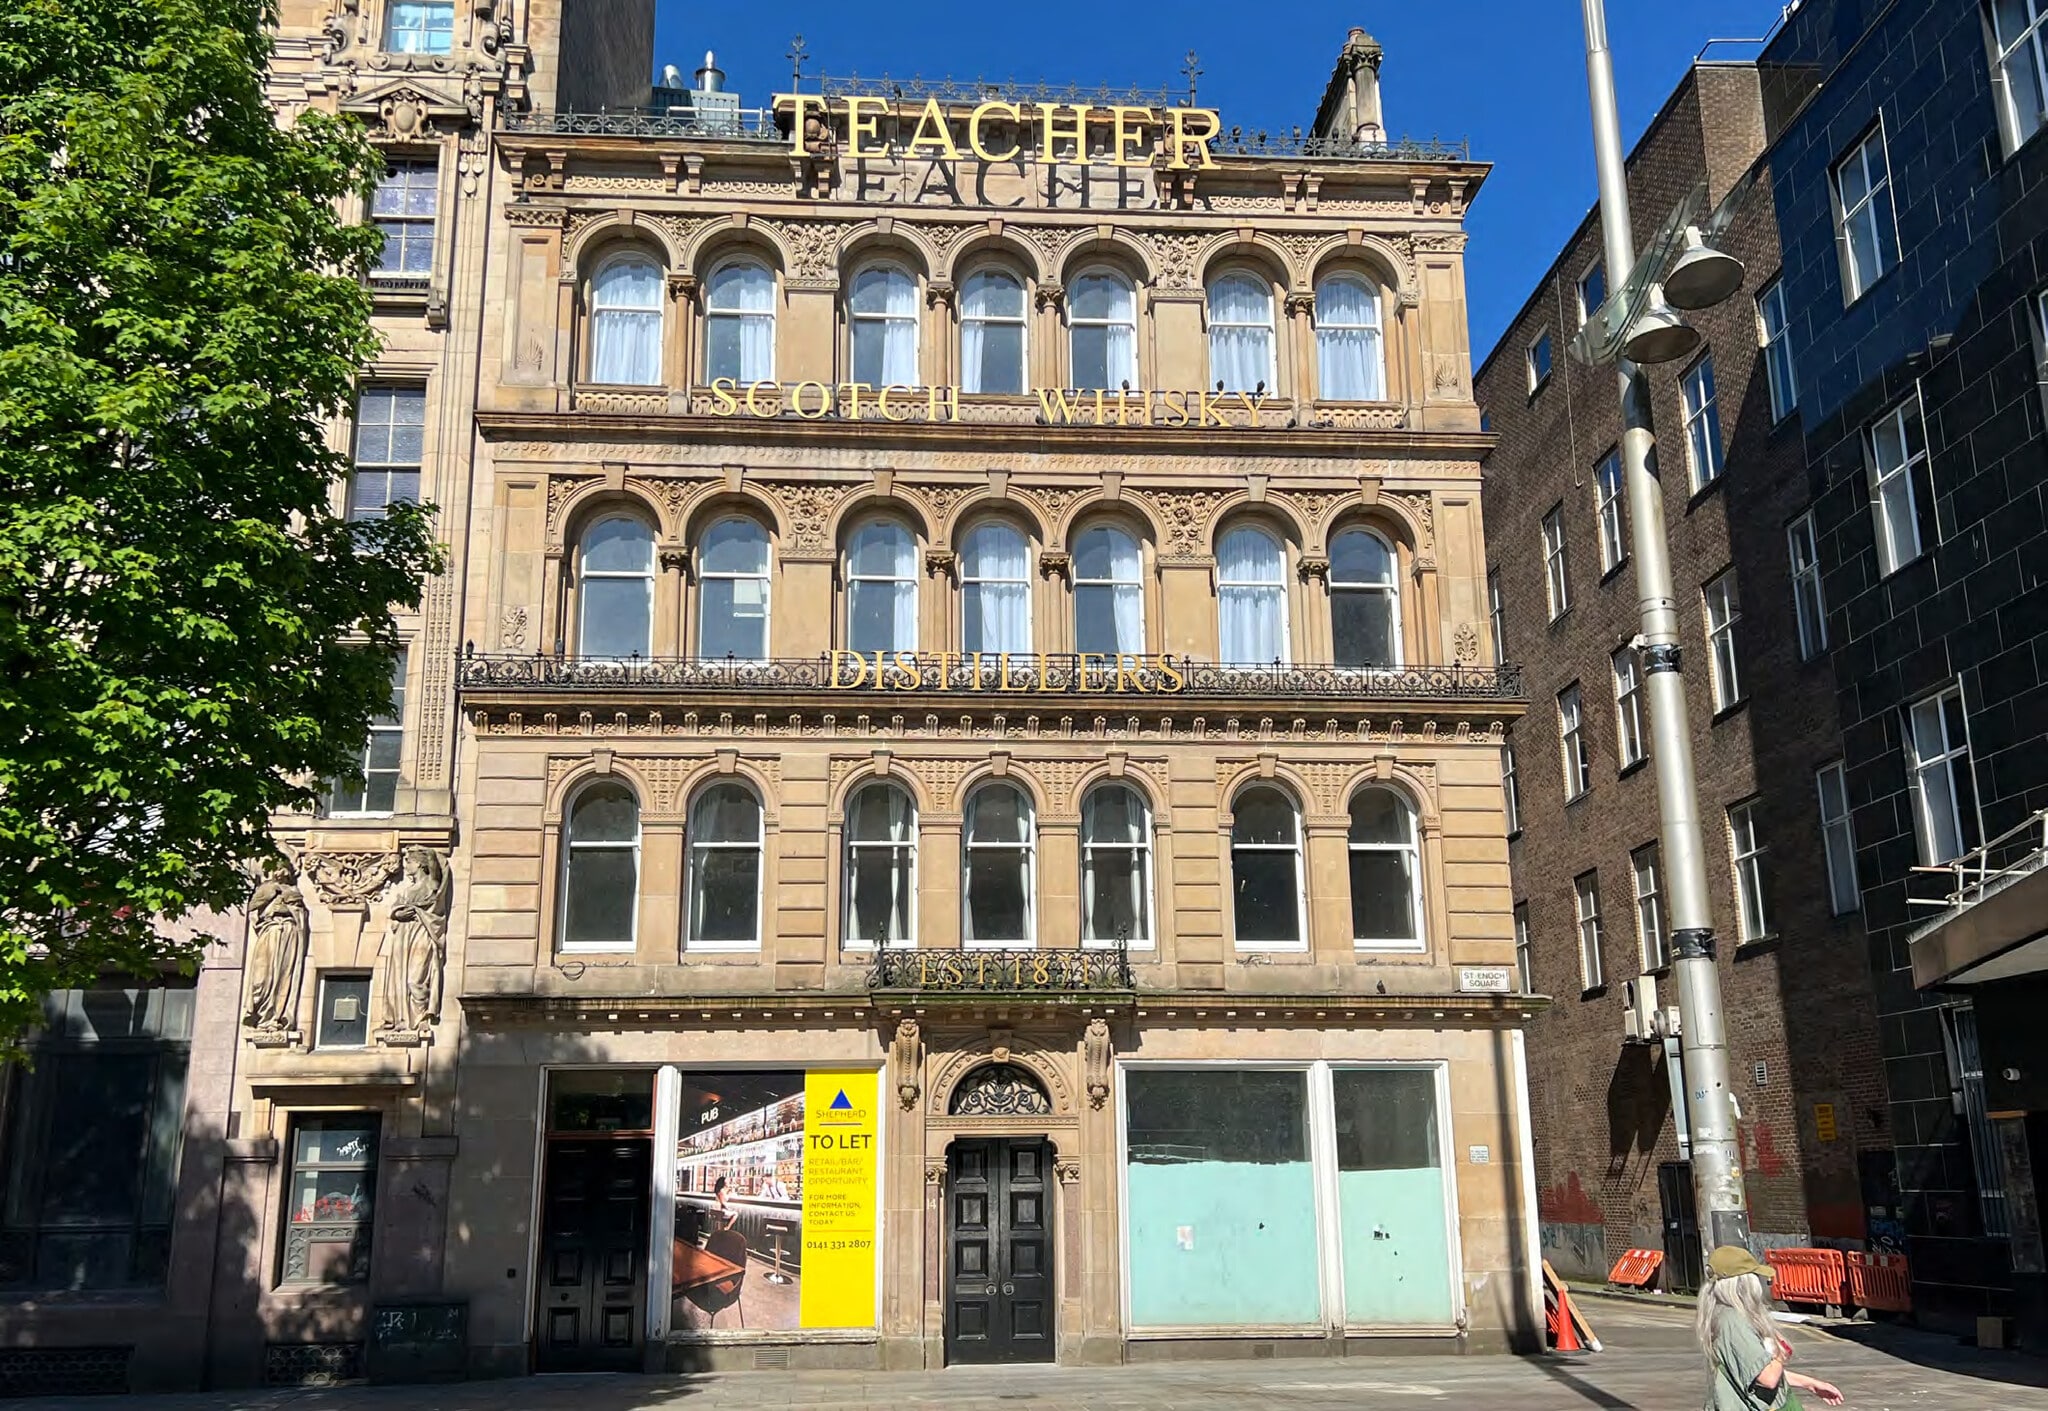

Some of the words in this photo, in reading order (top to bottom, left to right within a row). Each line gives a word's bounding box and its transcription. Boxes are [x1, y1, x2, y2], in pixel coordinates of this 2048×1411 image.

[773, 93, 1222, 170] TEACHER
[709, 377, 963, 423] SCOTCH
[1036, 386, 1272, 429] WHISKY
[829, 649, 1185, 693] DISTILLERS
[1012, 956, 1091, 986] 1871
[701, 1106, 719, 1125] PUB
[809, 1134, 834, 1150] TO
[839, 1134, 873, 1149] LET
[808, 1167, 864, 1176] RESTAURANT
[808, 1177, 868, 1186] OPPORTUNITY
[808, 1193, 825, 1201] FOR
[826, 1193, 847, 1201] MORE
[808, 1210, 844, 1218] CONTACT
[808, 1219, 834, 1227] TODAY
[806, 1240, 829, 1250] 0141
[830, 1240, 846, 1250] 331
[848, 1239, 872, 1249] 2807
